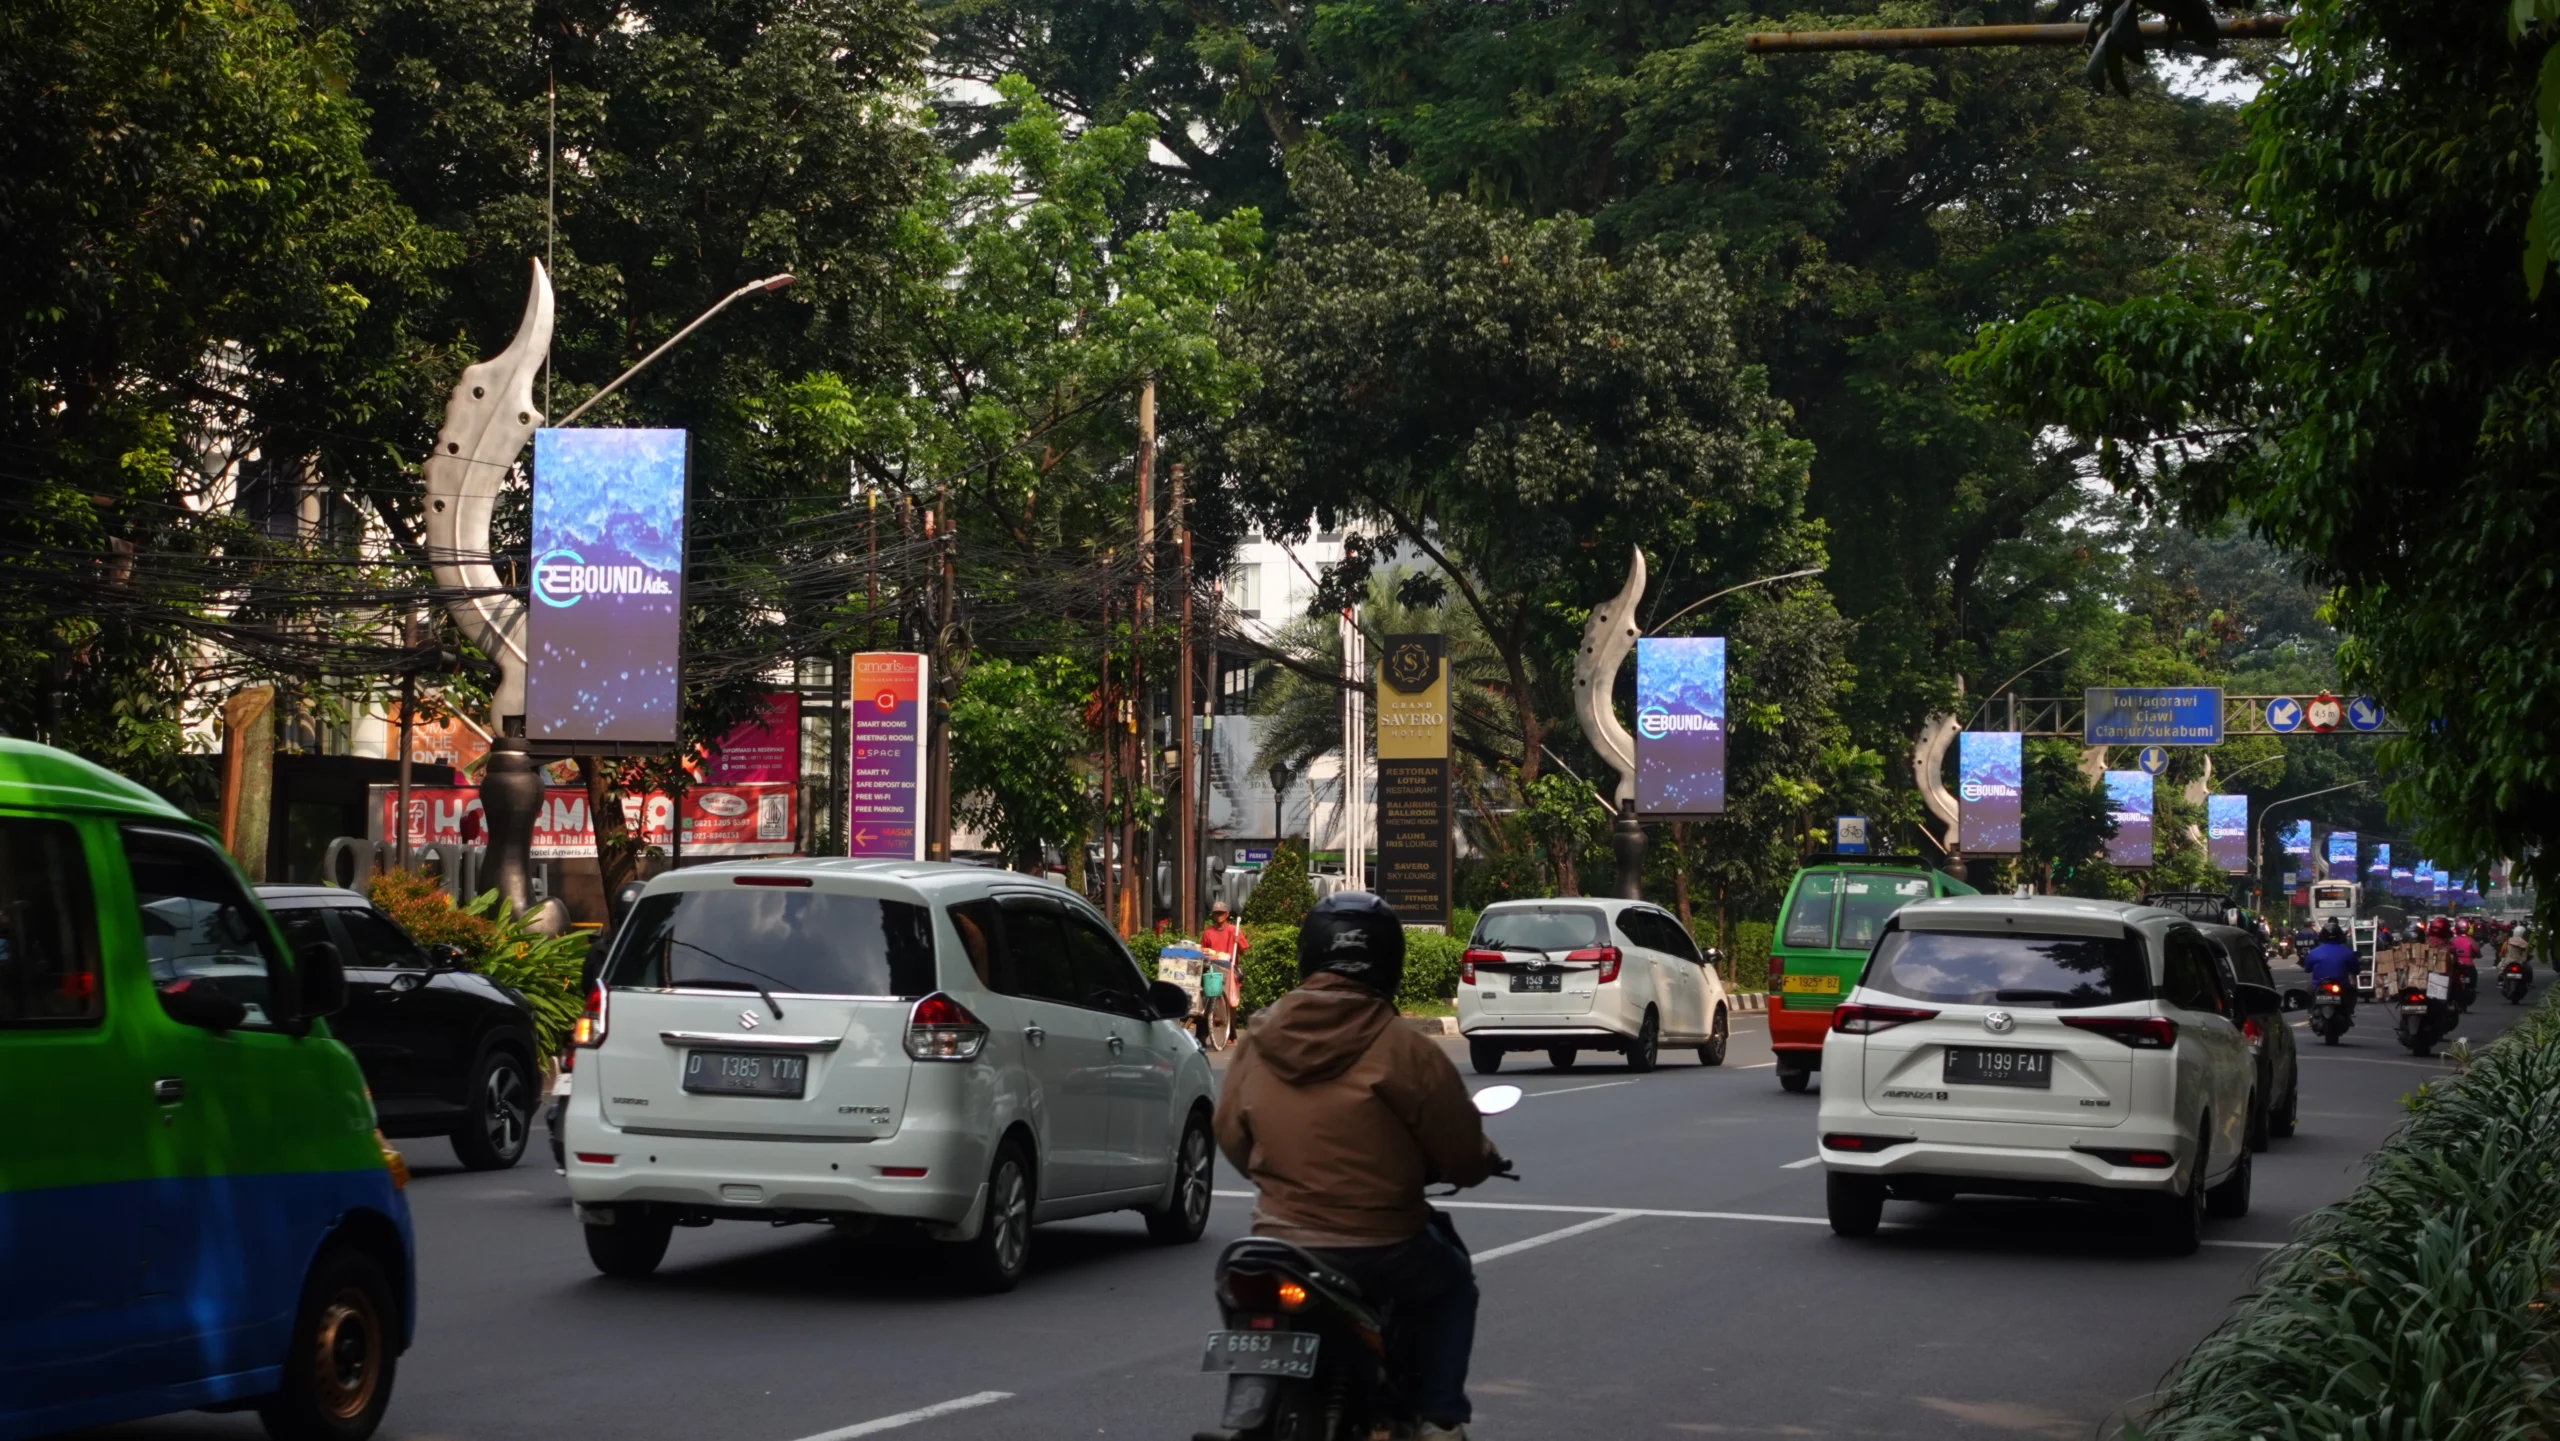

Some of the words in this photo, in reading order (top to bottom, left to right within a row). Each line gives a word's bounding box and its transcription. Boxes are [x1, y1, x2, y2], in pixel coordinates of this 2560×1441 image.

[538, 566, 642, 593] REBOUND
[643, 577, 672, 594] Ads.
[858, 660, 901, 673] amaris
[2113, 696, 2132, 707] Tol
[1381, 713, 1443, 726] SAVERO
[1642, 714, 1702, 731] REBOUND
[2136, 711, 2173, 722] Ciawi
[2096, 725, 2213, 739] Cianjur/Sukabumi
[425, 736, 452, 749] THE
[882, 828, 913, 836] MASUK
[1511, 976, 1517, 985] F
[1526, 976, 1543, 985] 1549
[1550, 975, 1559, 984] JS
[1783, 977, 1789, 986] F
[1828, 977, 1838, 988] BZ
[689, 1055, 702, 1074] D
[721, 1057, 760, 1077] 1385
[772, 1059, 801, 1079] YTX
[1949, 1051, 1958, 1067] F
[1978, 1052, 2012, 1070] 1199
[2017, 1054, 2043, 1072] FAI
[1882, 1090, 1934, 1100] AVANZA
[838, 1105, 890, 1114] ERTIGA
[1207, 1335, 1219, 1352] F
[1228, 1335, 1272, 1352] 6663
[1292, 1336, 1317, 1355] LV
